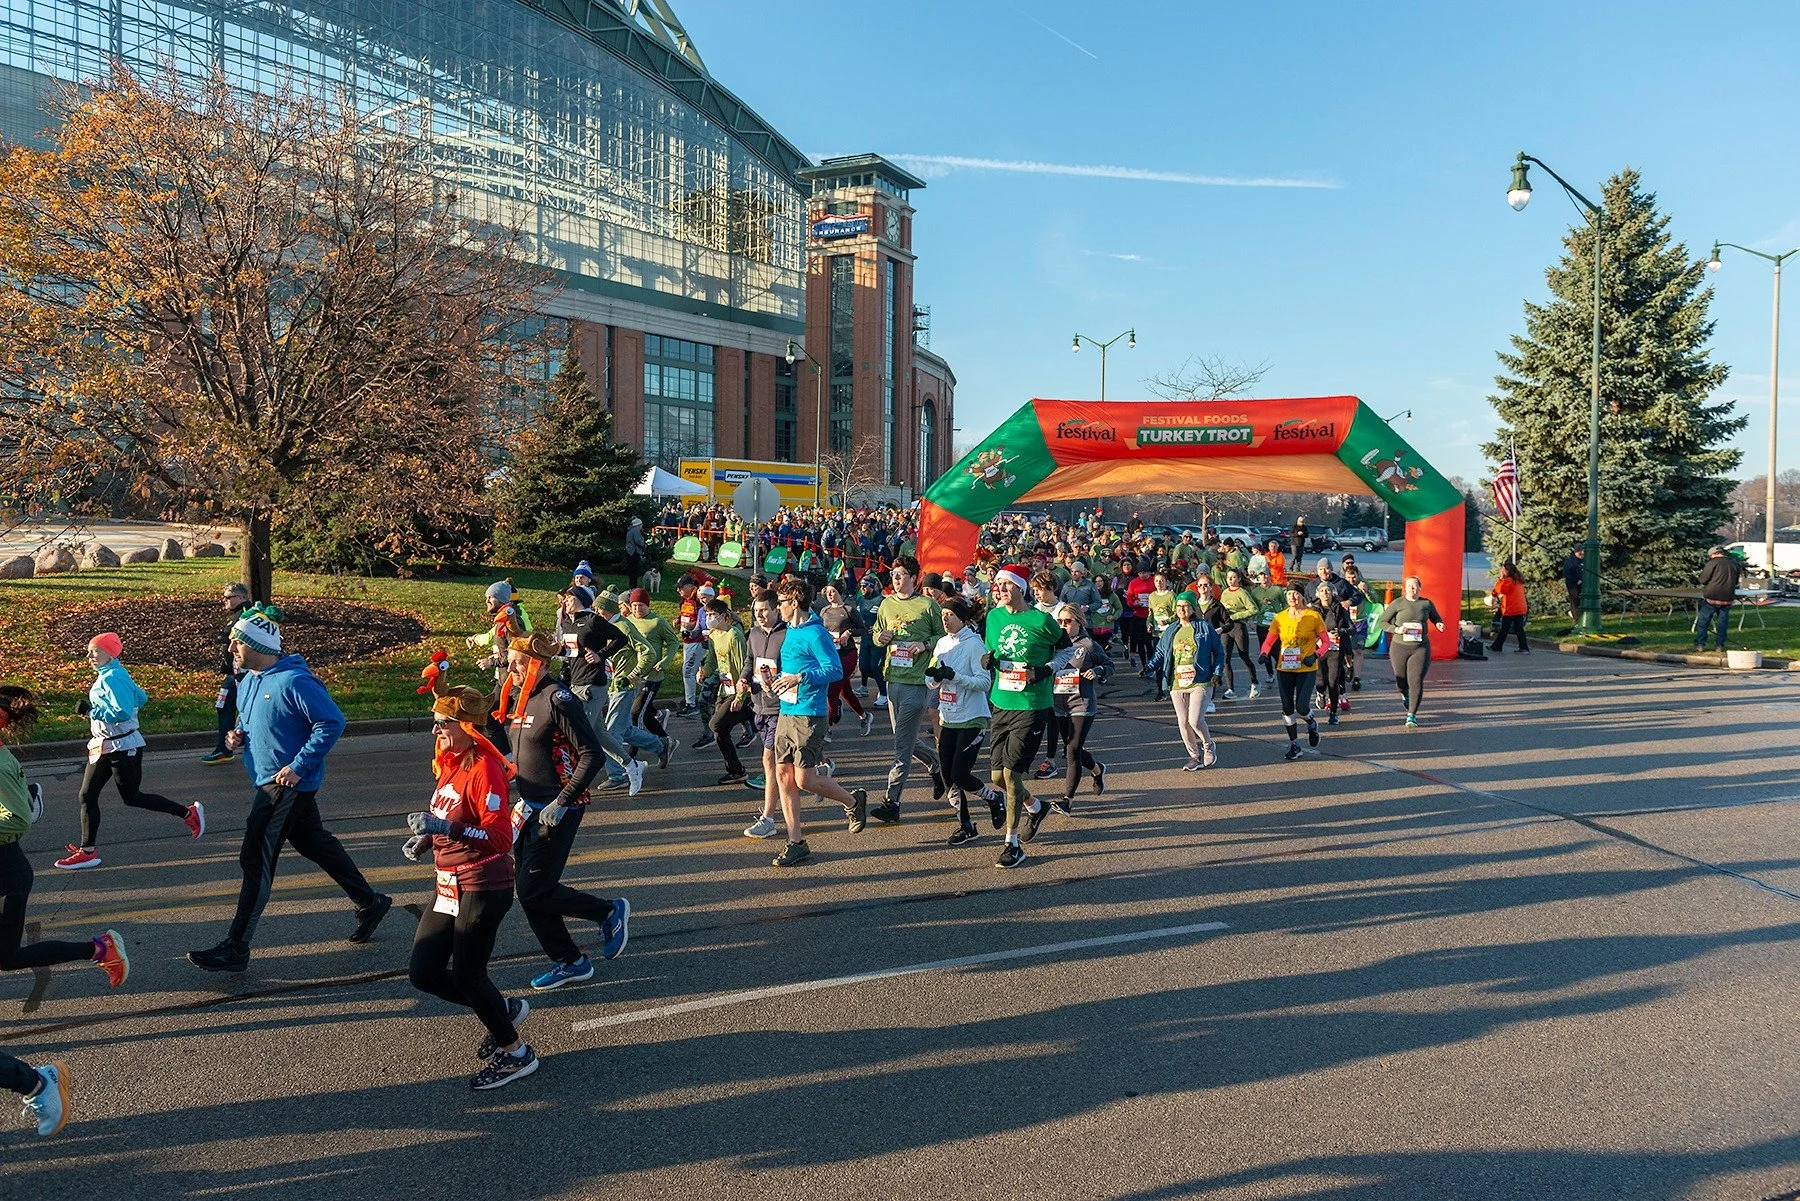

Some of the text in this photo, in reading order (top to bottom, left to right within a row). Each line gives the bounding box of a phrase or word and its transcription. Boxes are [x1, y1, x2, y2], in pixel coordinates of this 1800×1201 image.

[815, 226, 861, 235] INSURANCE
[1142, 414, 1249, 425] FESTIVAL FOODS
[1056, 421, 1116, 441] festival
[1140, 428, 1250, 442] TURKEY TROT
[1273, 422, 1334, 441] festival
[683, 467, 708, 475] PENSKE
[249, 616, 277, 636] BAY
